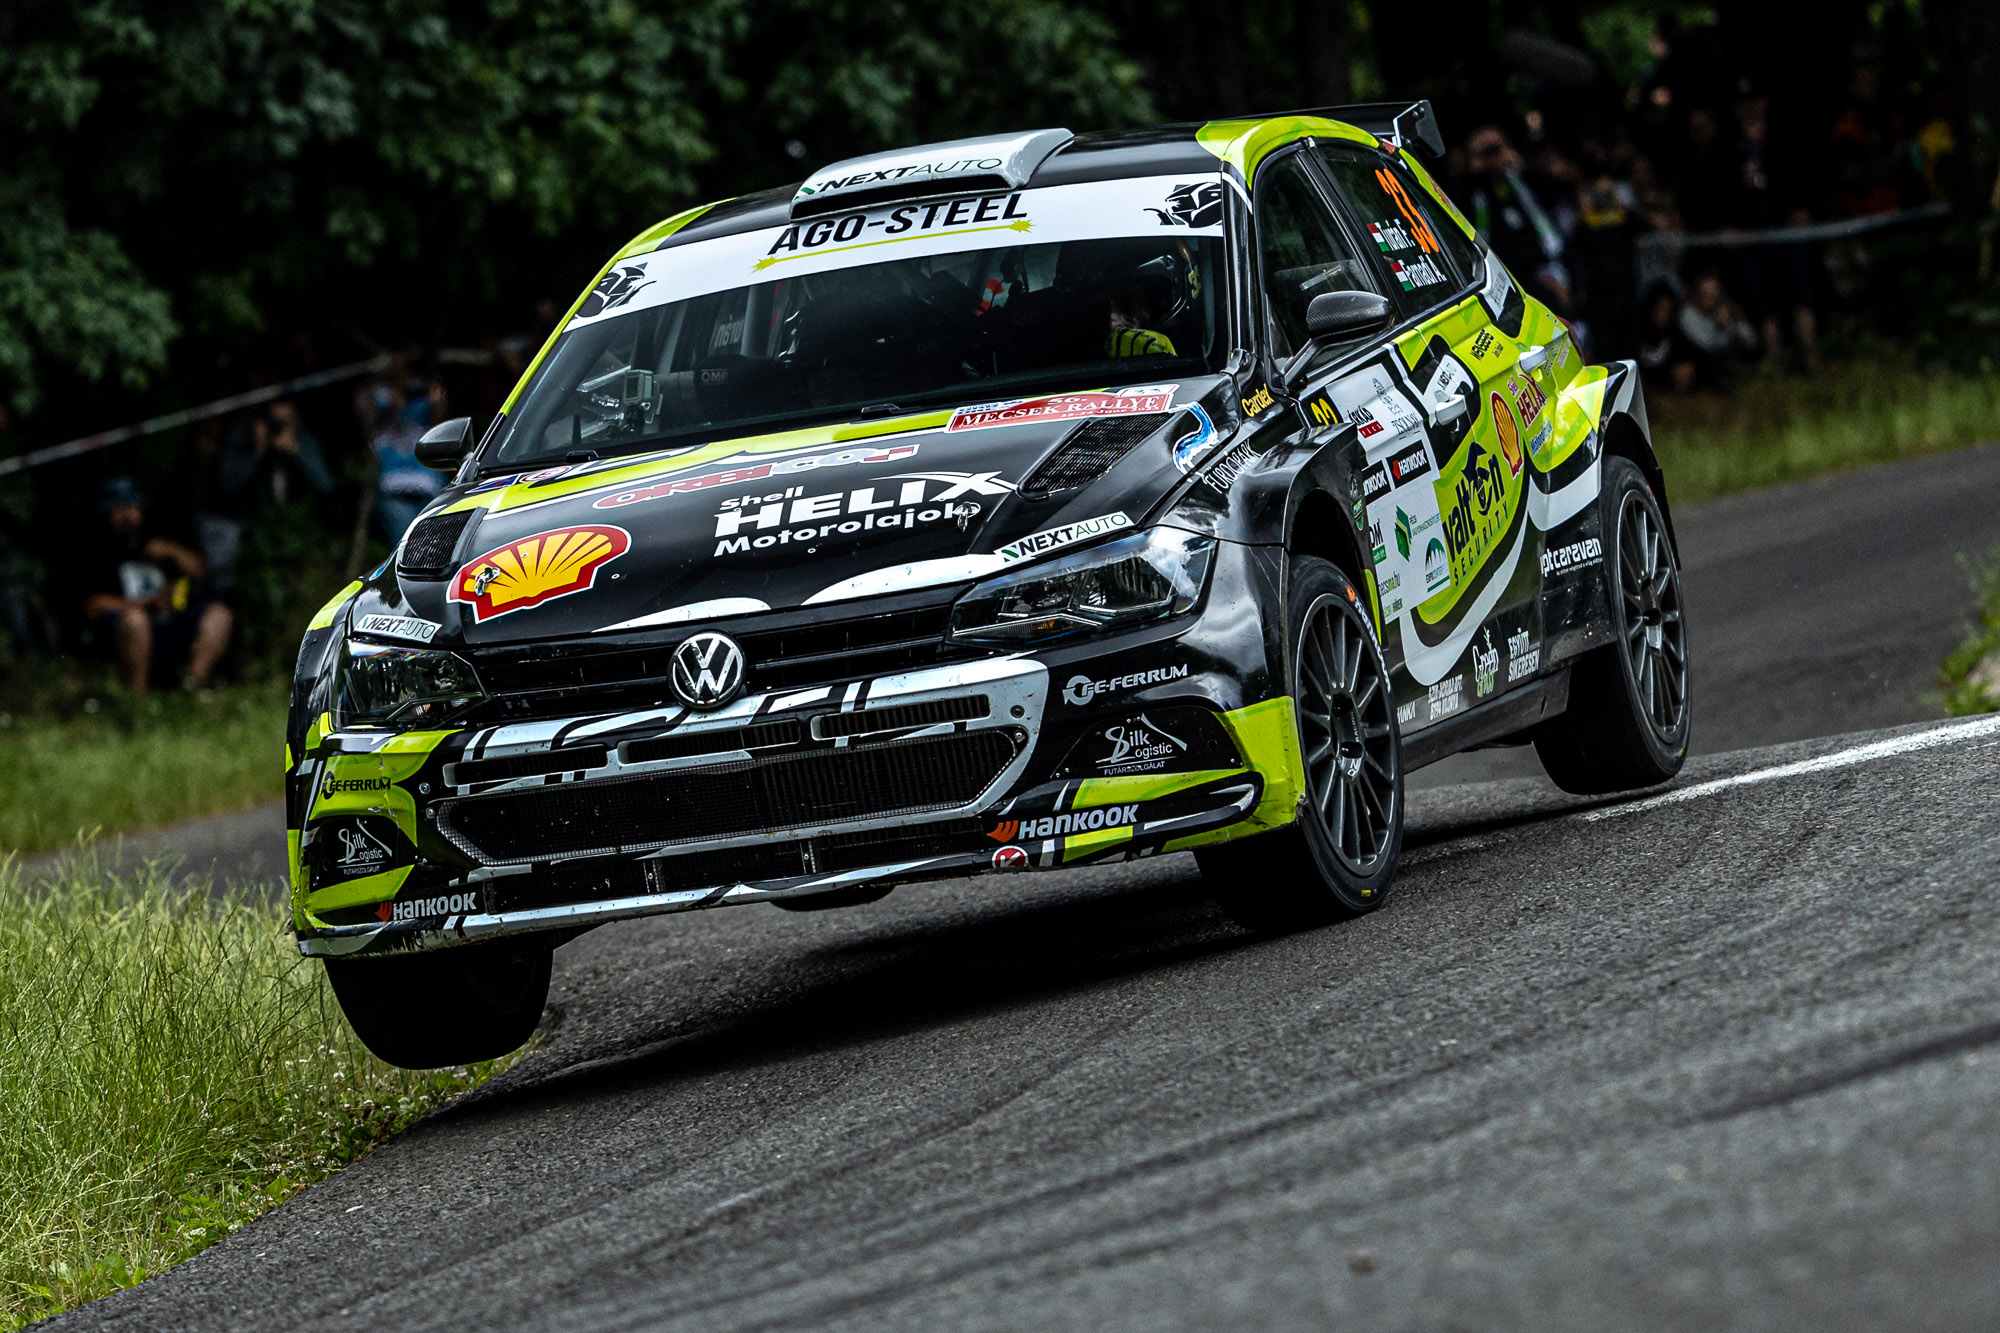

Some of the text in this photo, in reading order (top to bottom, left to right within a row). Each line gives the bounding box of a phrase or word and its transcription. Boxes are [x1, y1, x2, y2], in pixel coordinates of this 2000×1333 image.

[819, 158, 1003, 193] NEXTAUTO
[769, 193, 1028, 253] AGO-STEEL
[1393, 218, 1416, 248] F.
[960, 405, 1061, 428] MECSEK
[1067, 396, 1160, 412] RALLYE
[1241, 383, 1275, 417] Cardex
[713, 471, 1017, 538] HELIX
[719, 486, 804, 511] Shell
[1018, 513, 1129, 557] NEXTAUTO
[1454, 500, 1508, 587] SECURITY
[366, 617, 436, 639] NEXTAUTO
[673, 633, 743, 704] VW
[1081, 664, 1188, 696] FE-FERRUM
[329, 777, 391, 792] FE-FERRUM
